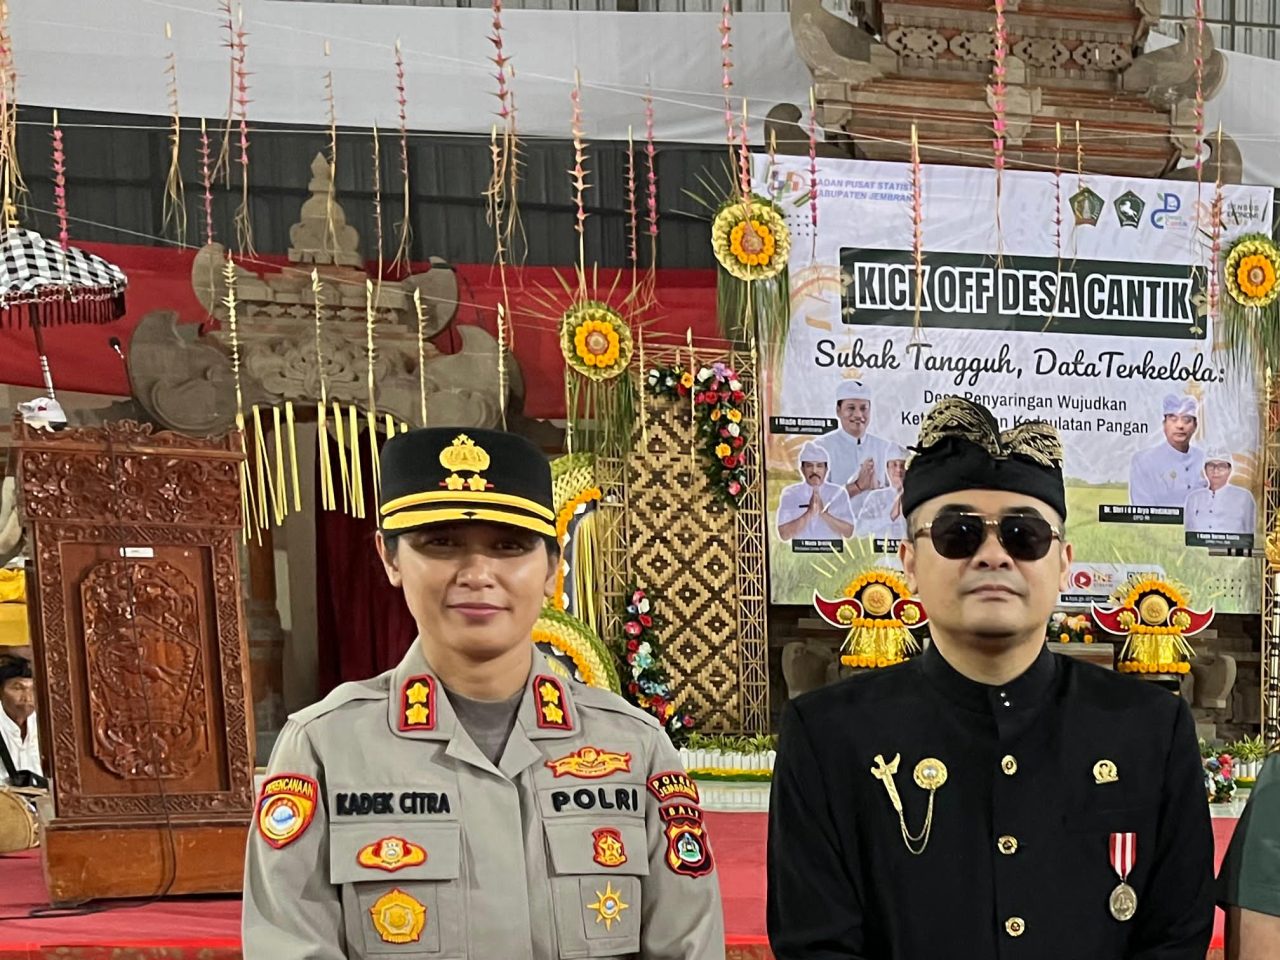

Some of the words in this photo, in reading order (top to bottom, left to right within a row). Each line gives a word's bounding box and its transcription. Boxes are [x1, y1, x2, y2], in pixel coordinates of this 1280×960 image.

[817, 178, 844, 188] ADAN
[845, 180, 875, 189] PUSAT
[877, 182, 914, 191] STATIST
[817, 189, 867, 200] ABUPATEN
[869, 192, 913, 202] JEMBRAN
[855, 264, 931, 309] KICK
[936, 266, 994, 312] OFF
[999, 269, 1078, 317] DESA
[1085, 274, 1193, 322] CANTIK
[815, 338, 900, 369] Subak
[905, 343, 1023, 386] Tangguh,
[964, 391, 1053, 410] Penyaringan
[1057, 395, 1127, 412] Wujudkan
[1096, 418, 1149, 436] Pangan
[336, 791, 394, 815] KADEK
[399, 791, 450, 815] CITRA
[551, 787, 638, 812] POLRI
[668, 805, 699, 818] BALI
